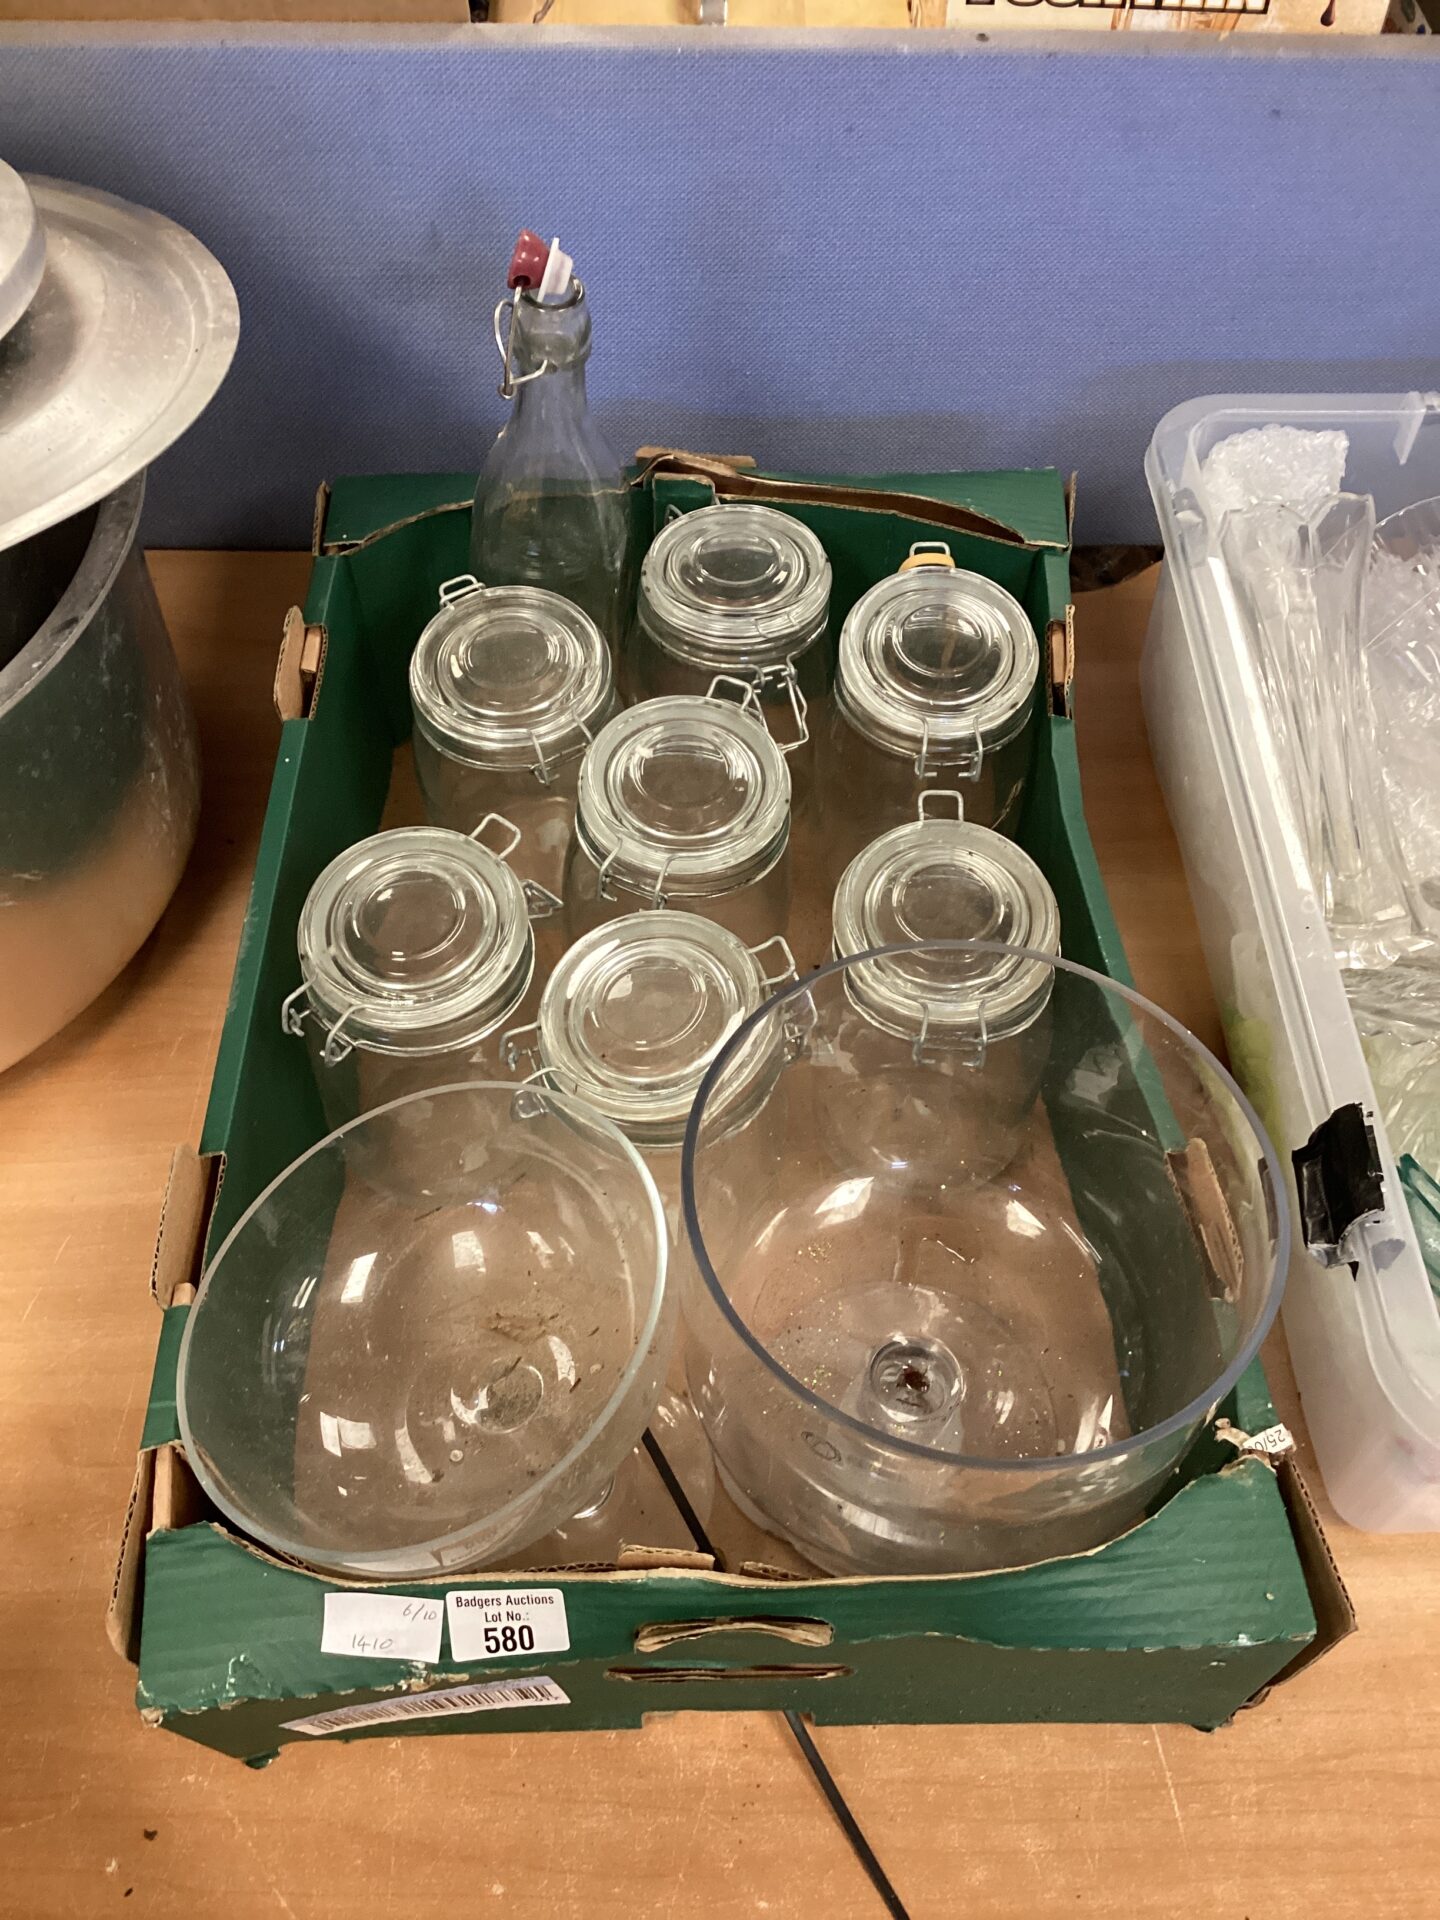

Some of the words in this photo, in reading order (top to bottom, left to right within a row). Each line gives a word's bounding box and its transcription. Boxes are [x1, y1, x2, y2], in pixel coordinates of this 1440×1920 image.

[455, 1596, 502, 1609] Badgers
[505, 1594, 555, 1606] Auctions
[484, 1611, 502, 1623] Lot
[483, 1624, 535, 1654] 580
